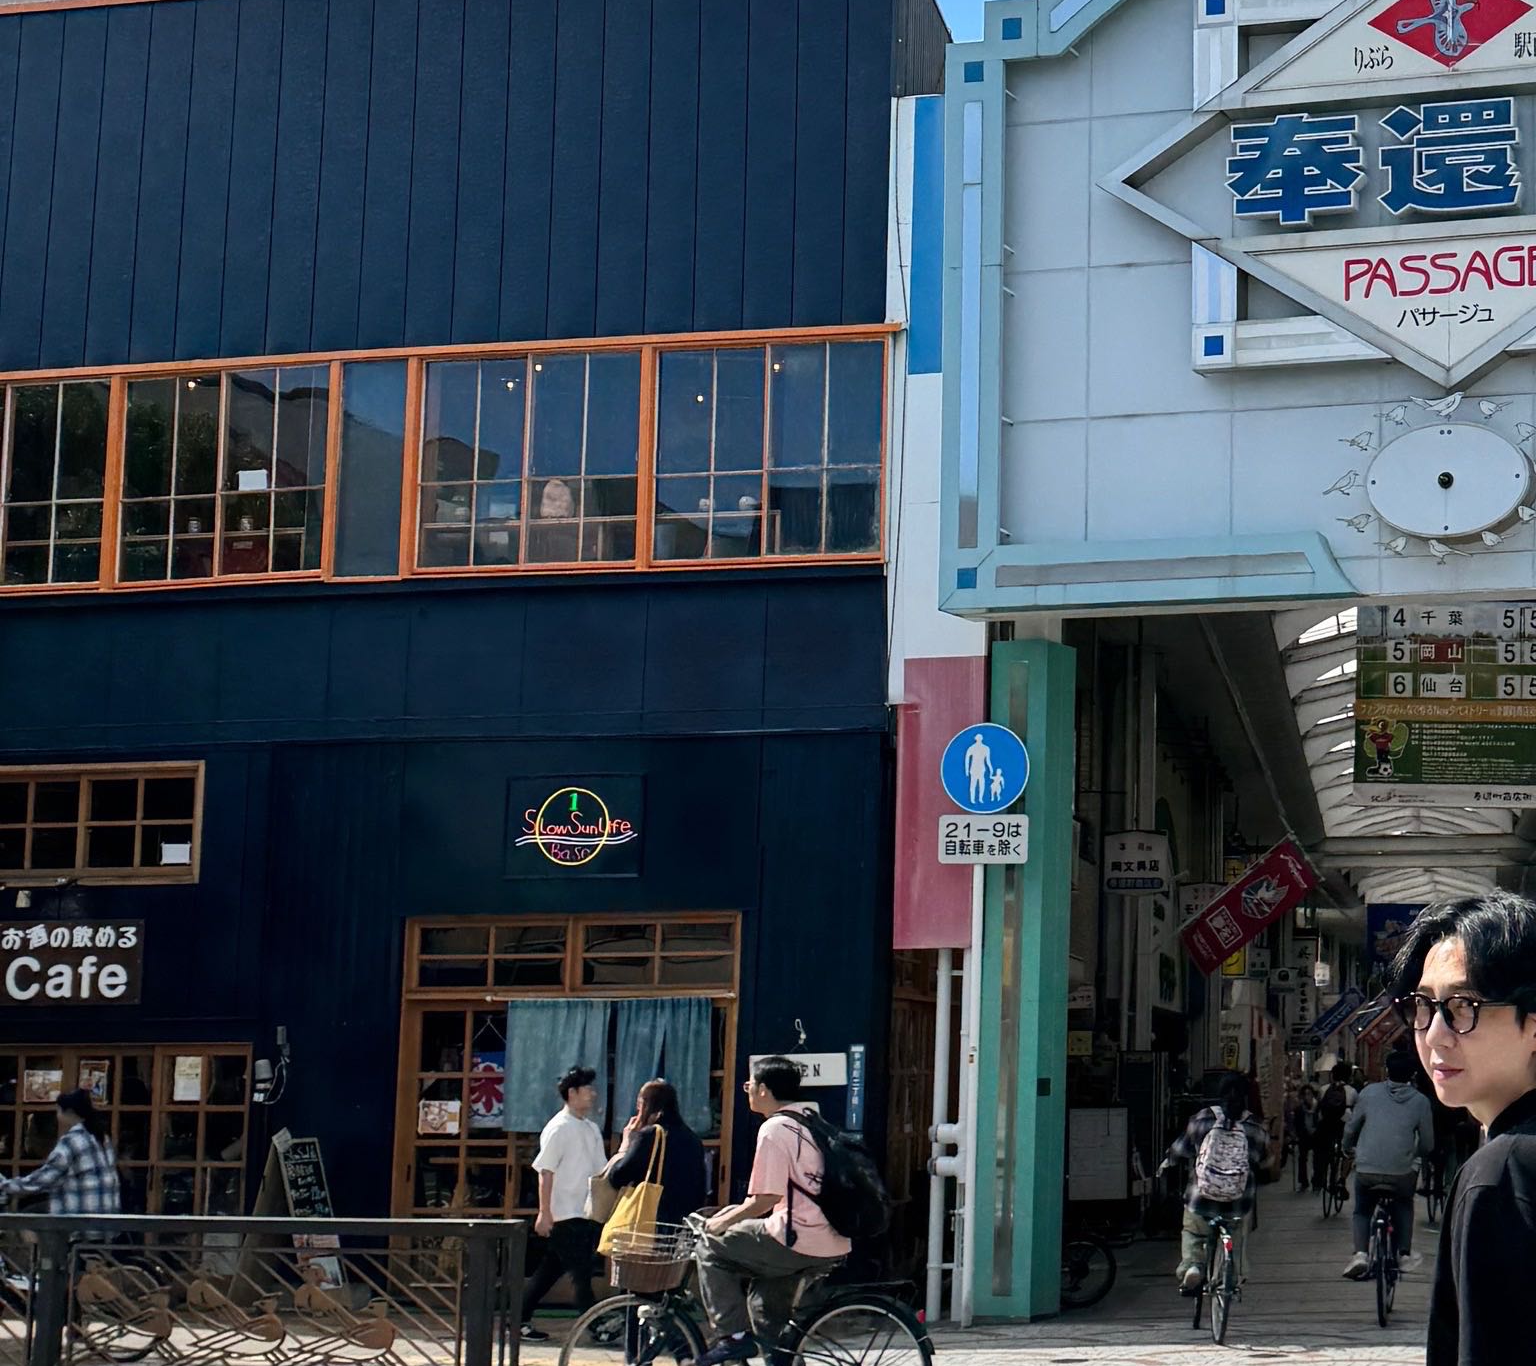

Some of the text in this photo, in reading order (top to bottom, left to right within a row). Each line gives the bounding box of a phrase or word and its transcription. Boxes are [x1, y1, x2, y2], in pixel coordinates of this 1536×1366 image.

[1354, 44, 1394, 75] りぶら
[1396, 303, 1495, 328] パサージュ
[1393, 607, 1407, 628] 4
[1420, 610, 1464, 626] 千葉
[1392, 641, 1405, 662] 5
[1420, 643, 1463, 661] 岡山
[1393, 675, 1406, 695] 6
[1421, 677, 1463, 694] 仙台
[945, 839, 1022, 856] 自転車を除く
[1, 923, 138, 950] お酒の飲める
[5, 955, 128, 1001] Cafe
